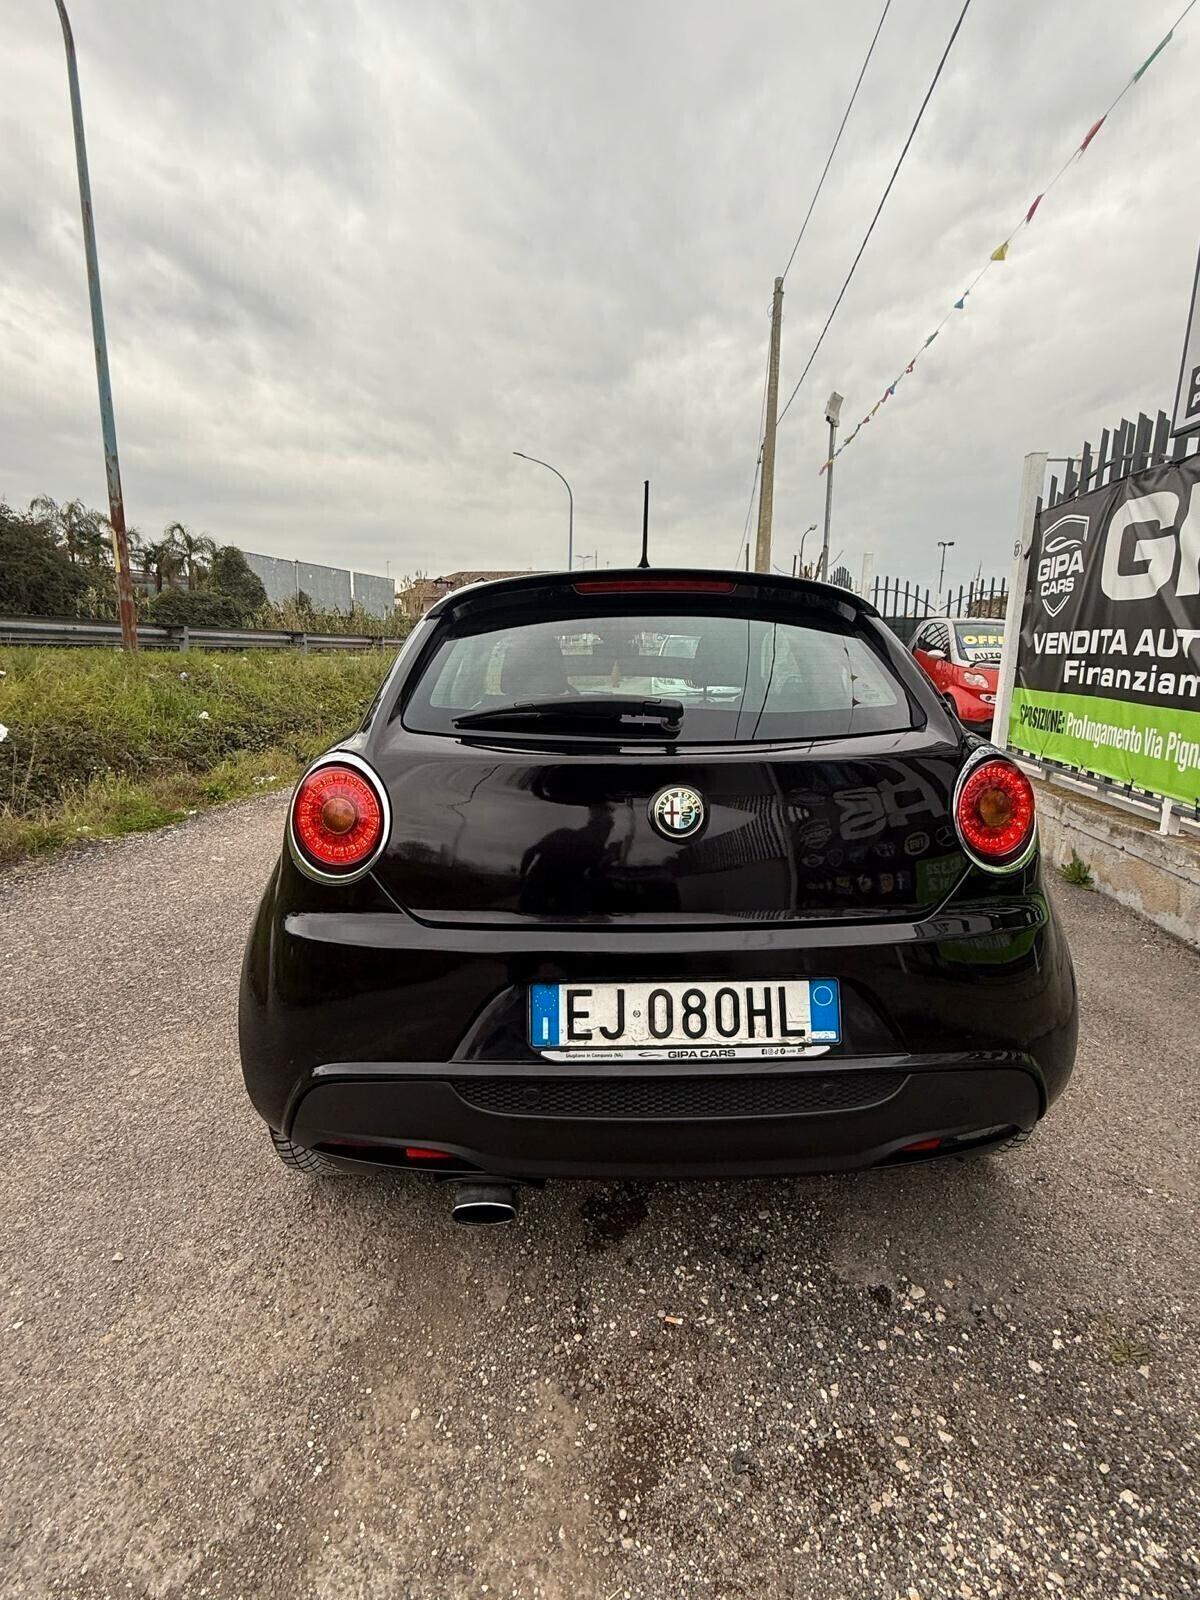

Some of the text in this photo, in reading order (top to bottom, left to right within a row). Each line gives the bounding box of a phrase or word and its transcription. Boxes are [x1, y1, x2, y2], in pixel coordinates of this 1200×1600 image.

[1037, 549, 1084, 582] GIPA
[1040, 577, 1075, 596] CARS
[1033, 629, 1128, 655] VENDITA
[1065, 712, 1142, 754] Prolungamento
[1144, 727, 1163, 760] Via
[566, 988, 625, 1041] EJ
[648, 986, 806, 1040] 080HL
[667, 1049, 736, 1059] GIPA CARS
